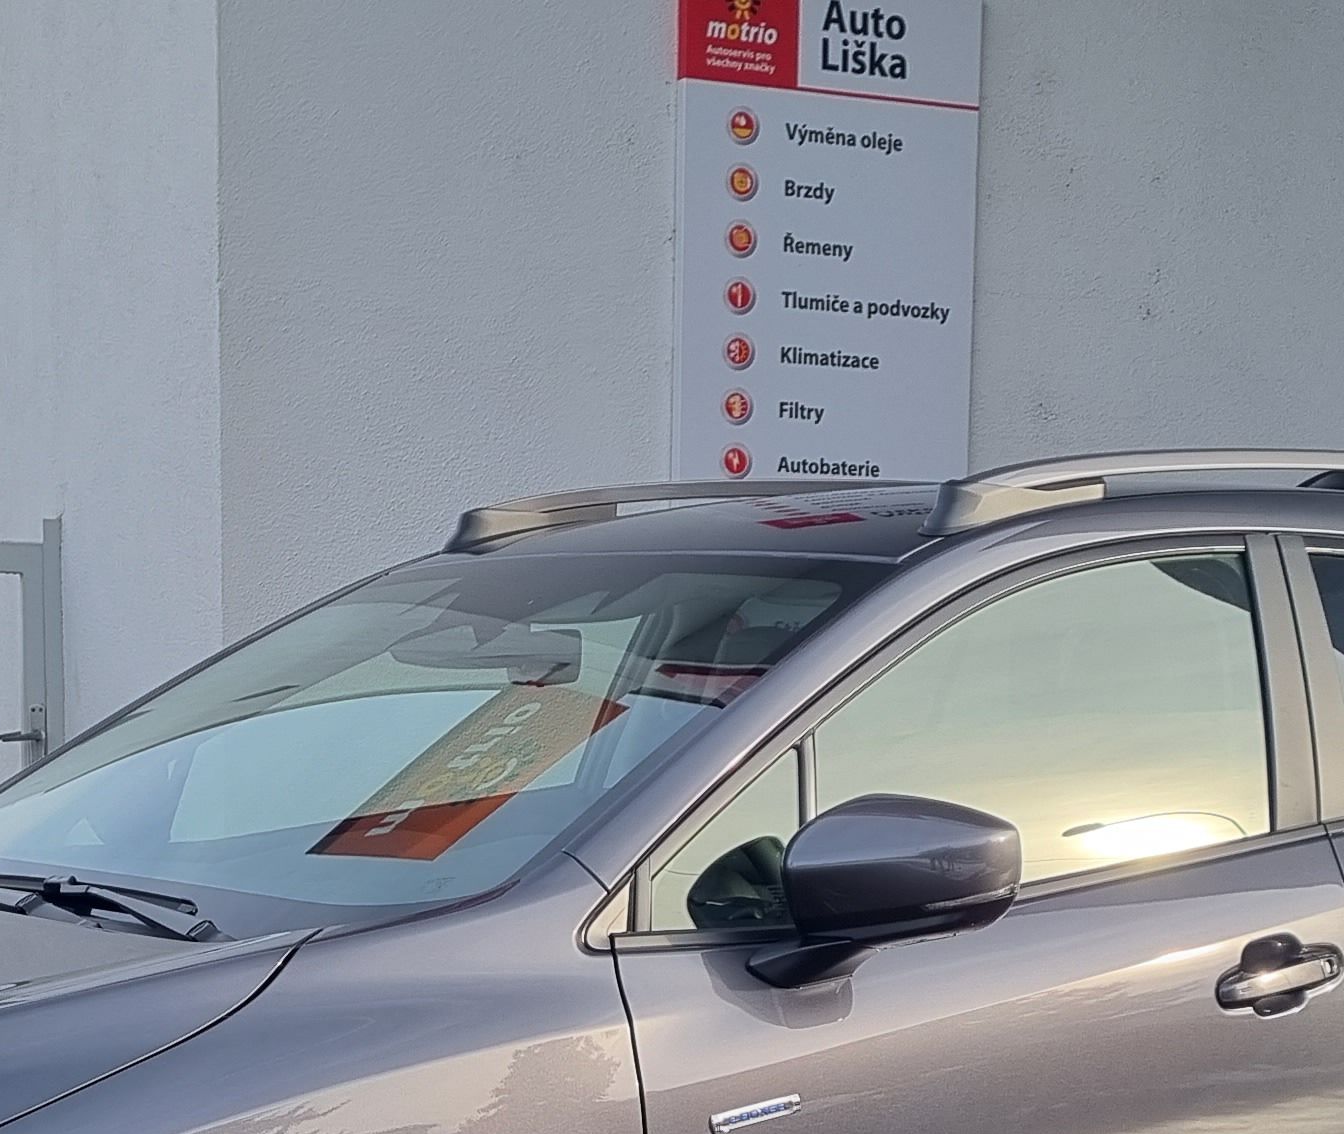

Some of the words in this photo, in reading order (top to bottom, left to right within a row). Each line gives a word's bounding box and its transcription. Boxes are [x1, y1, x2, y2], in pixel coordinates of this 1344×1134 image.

[706, 20, 778, 45] motrio
[822, 0, 906, 40] Auto
[706, 44, 754, 59] Autoservis
[755, 52, 772, 62] pro
[821, 38, 907, 80] Liška
[785, 122, 857, 147] Výměna
[860, 132, 904, 156] oleje
[784, 180, 835, 205] Brzdy
[783, 233, 854, 262] Řemeny
[781, 291, 850, 313] Tlumiče
[853, 302, 863, 314] a
[867, 300, 950, 324] podvozky
[780, 347, 880, 370] Klimatizace
[779, 402, 825, 424] Filtry
[777, 457, 881, 477] Autobaterie
